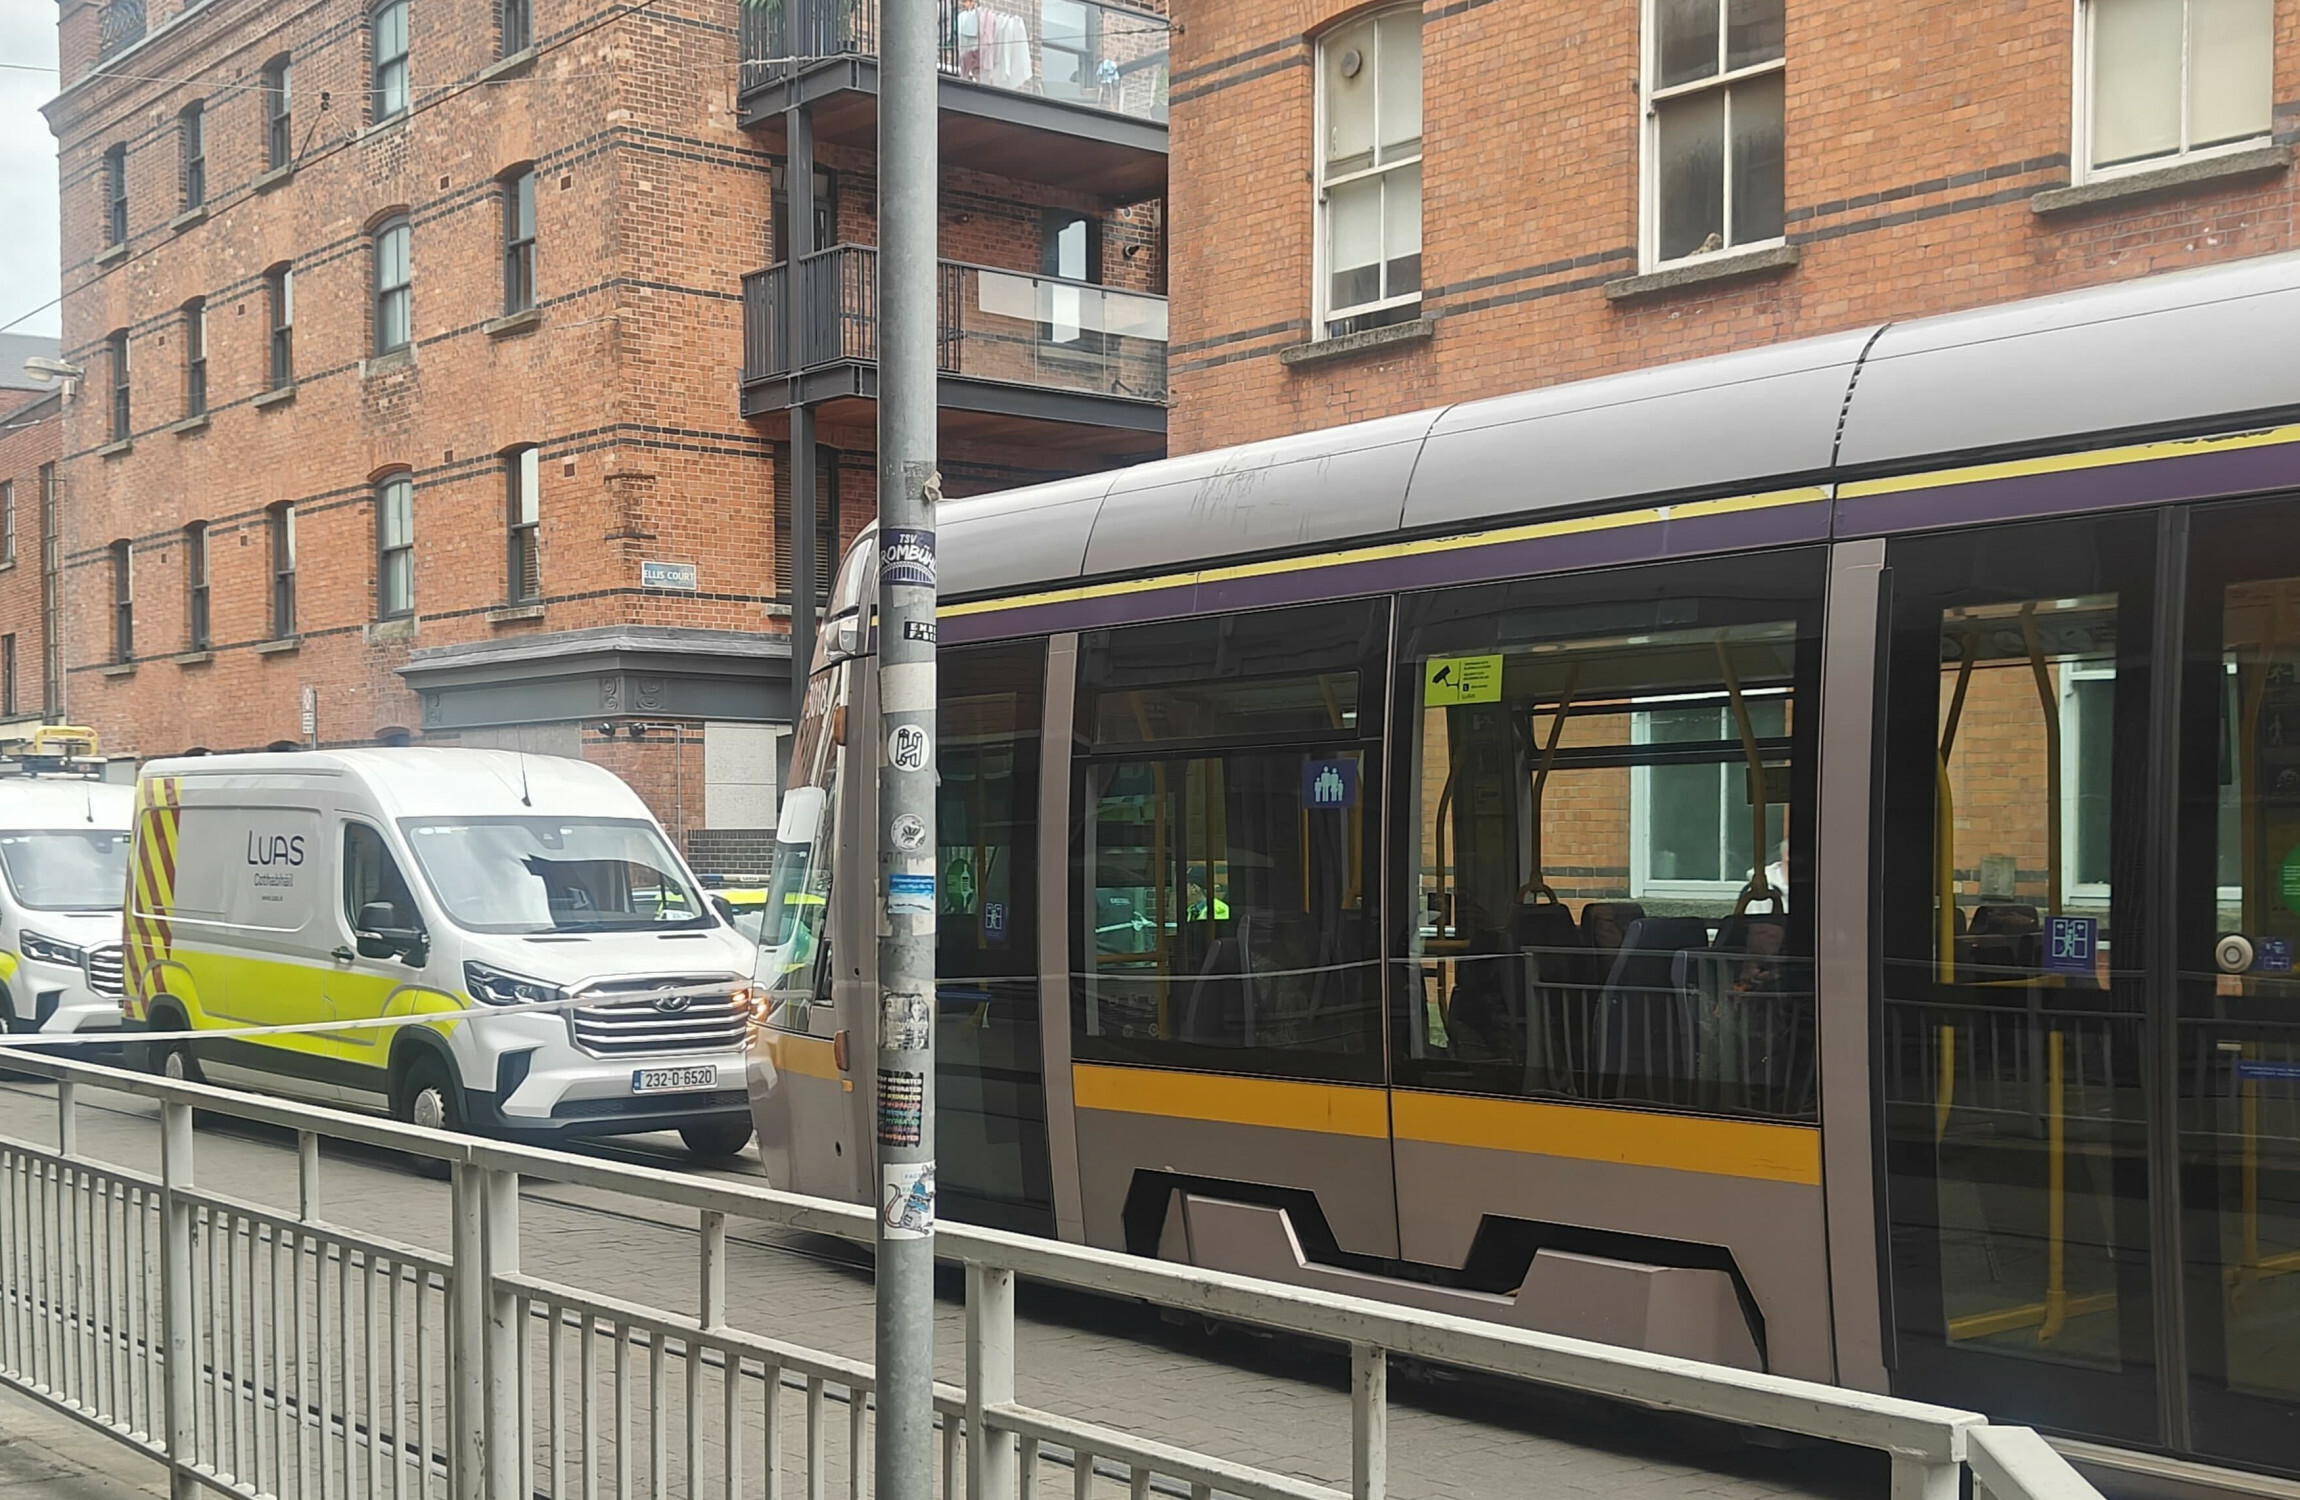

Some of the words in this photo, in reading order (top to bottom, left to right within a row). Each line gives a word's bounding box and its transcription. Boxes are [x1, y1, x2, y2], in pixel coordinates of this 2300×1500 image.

[899, 533, 918, 543] TSV
[880, 544, 937, 573] ROMBÜHL
[644, 570, 665, 579] ELLIS
[667, 571, 694, 581] COURT
[247, 830, 305, 866] LUAS
[645, 1070, 712, 1088] 232-D-6520
